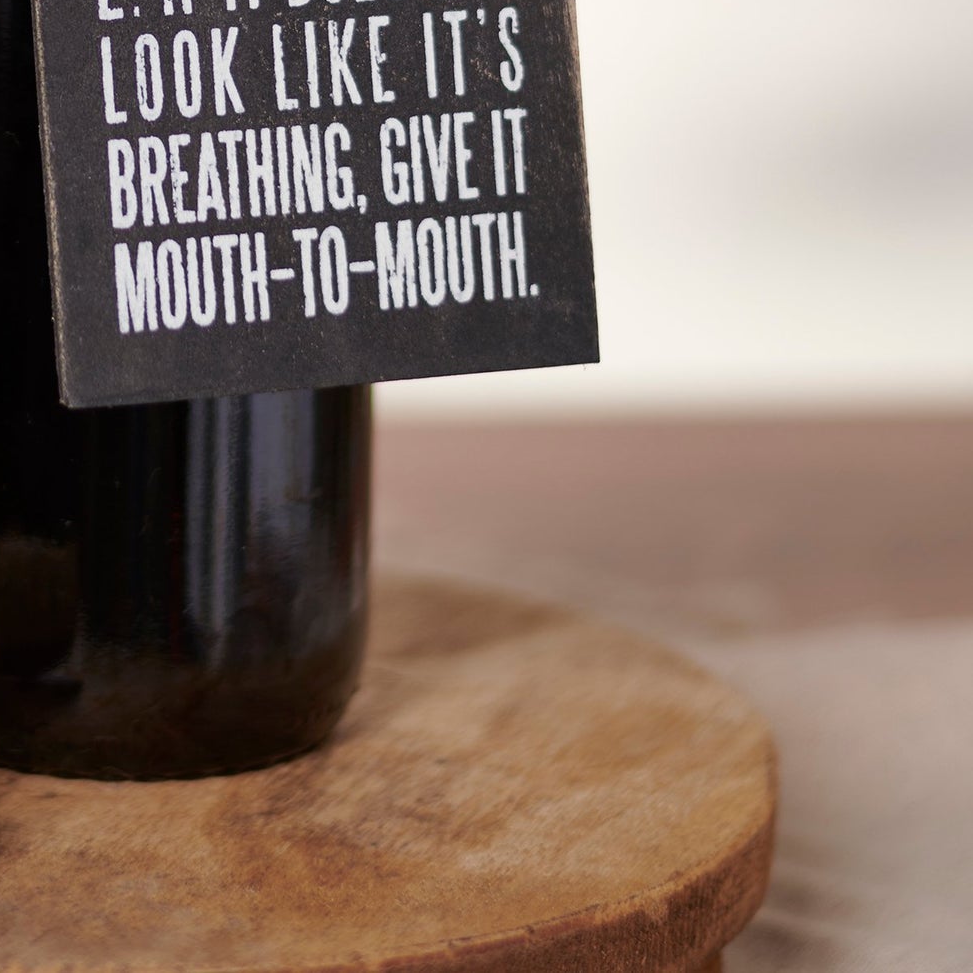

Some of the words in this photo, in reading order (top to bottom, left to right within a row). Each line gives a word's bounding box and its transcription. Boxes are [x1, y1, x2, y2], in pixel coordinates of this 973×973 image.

[100, 26, 244, 124] LOOK
[272, 15, 395, 113] LIKE
[422, 6, 524, 99] IT'S
[108, 122, 367, 229] BREATHING,
[380, 111, 479, 207] GIVE
[490, 108, 527, 197] IT
[114, 211, 538, 333] MOUTH-TO-MOUTH.
